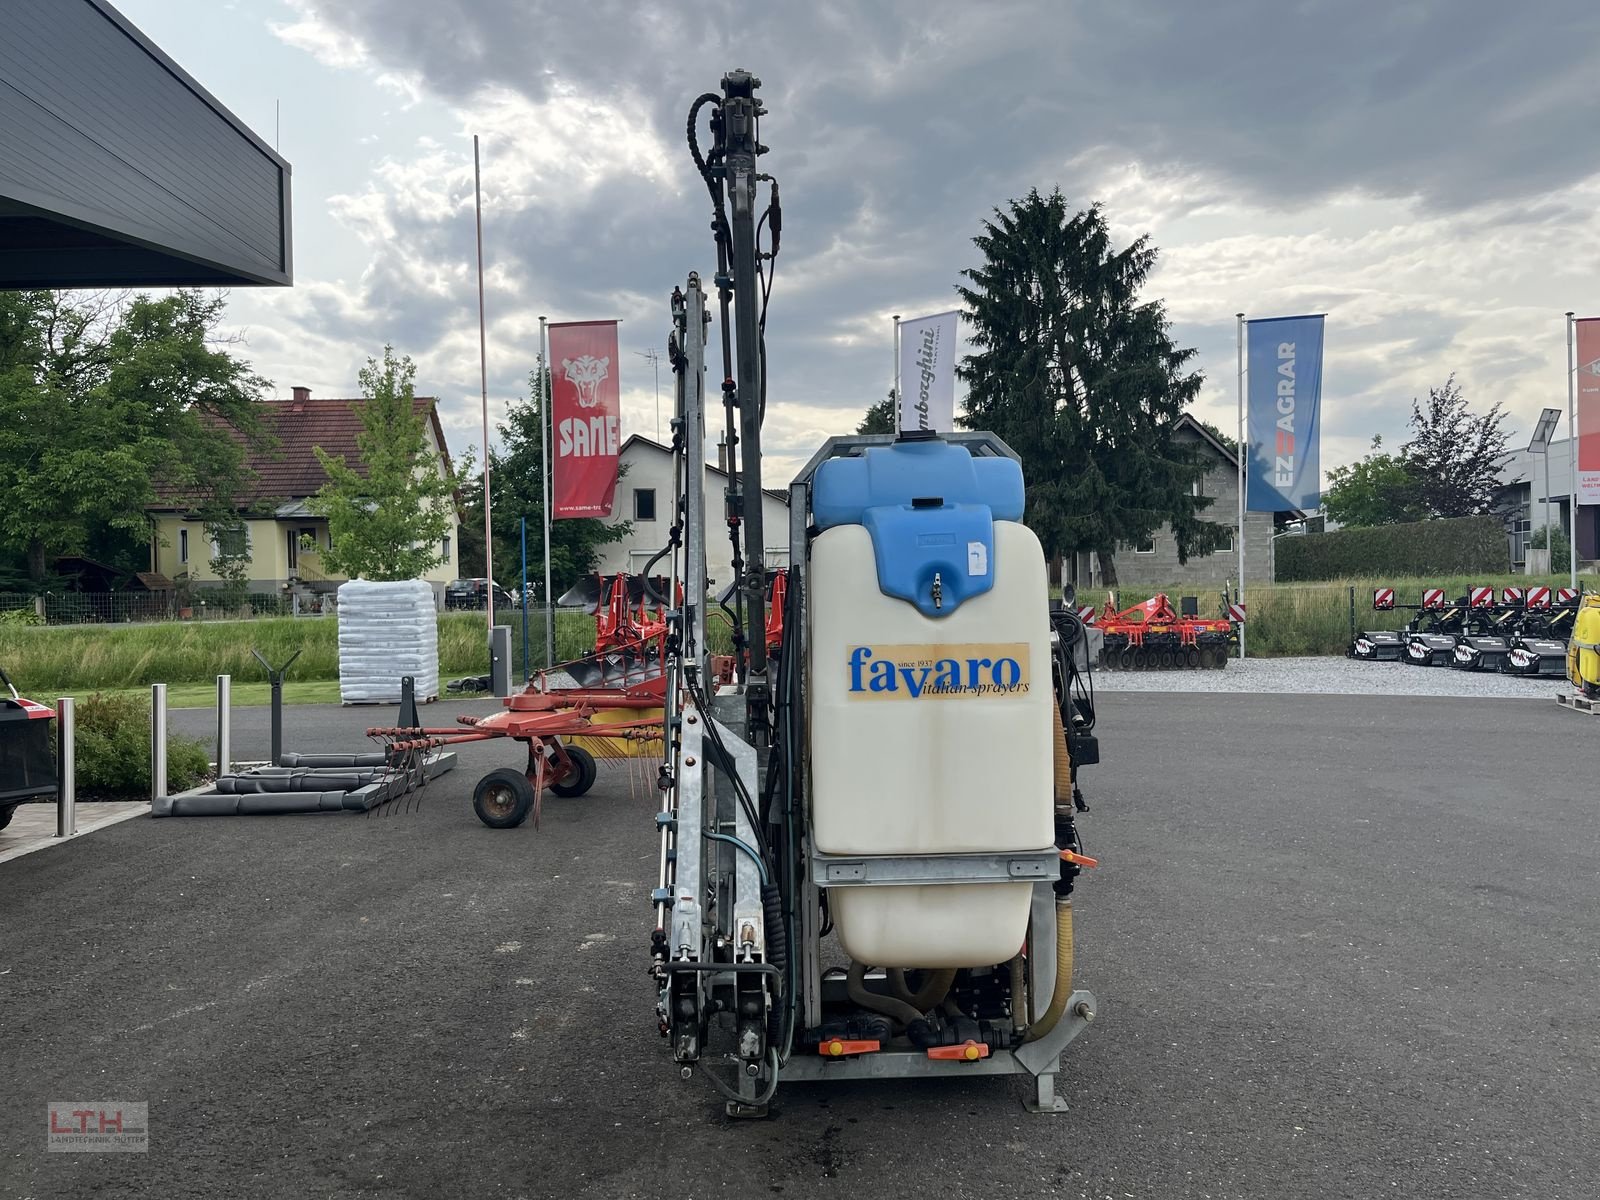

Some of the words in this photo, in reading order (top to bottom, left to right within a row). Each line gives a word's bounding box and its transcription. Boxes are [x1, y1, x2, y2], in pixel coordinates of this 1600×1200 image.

[1276, 342, 1296, 433] AGRAR
[559, 416, 618, 457] SAME
[848, 647, 1021, 698] favaro
